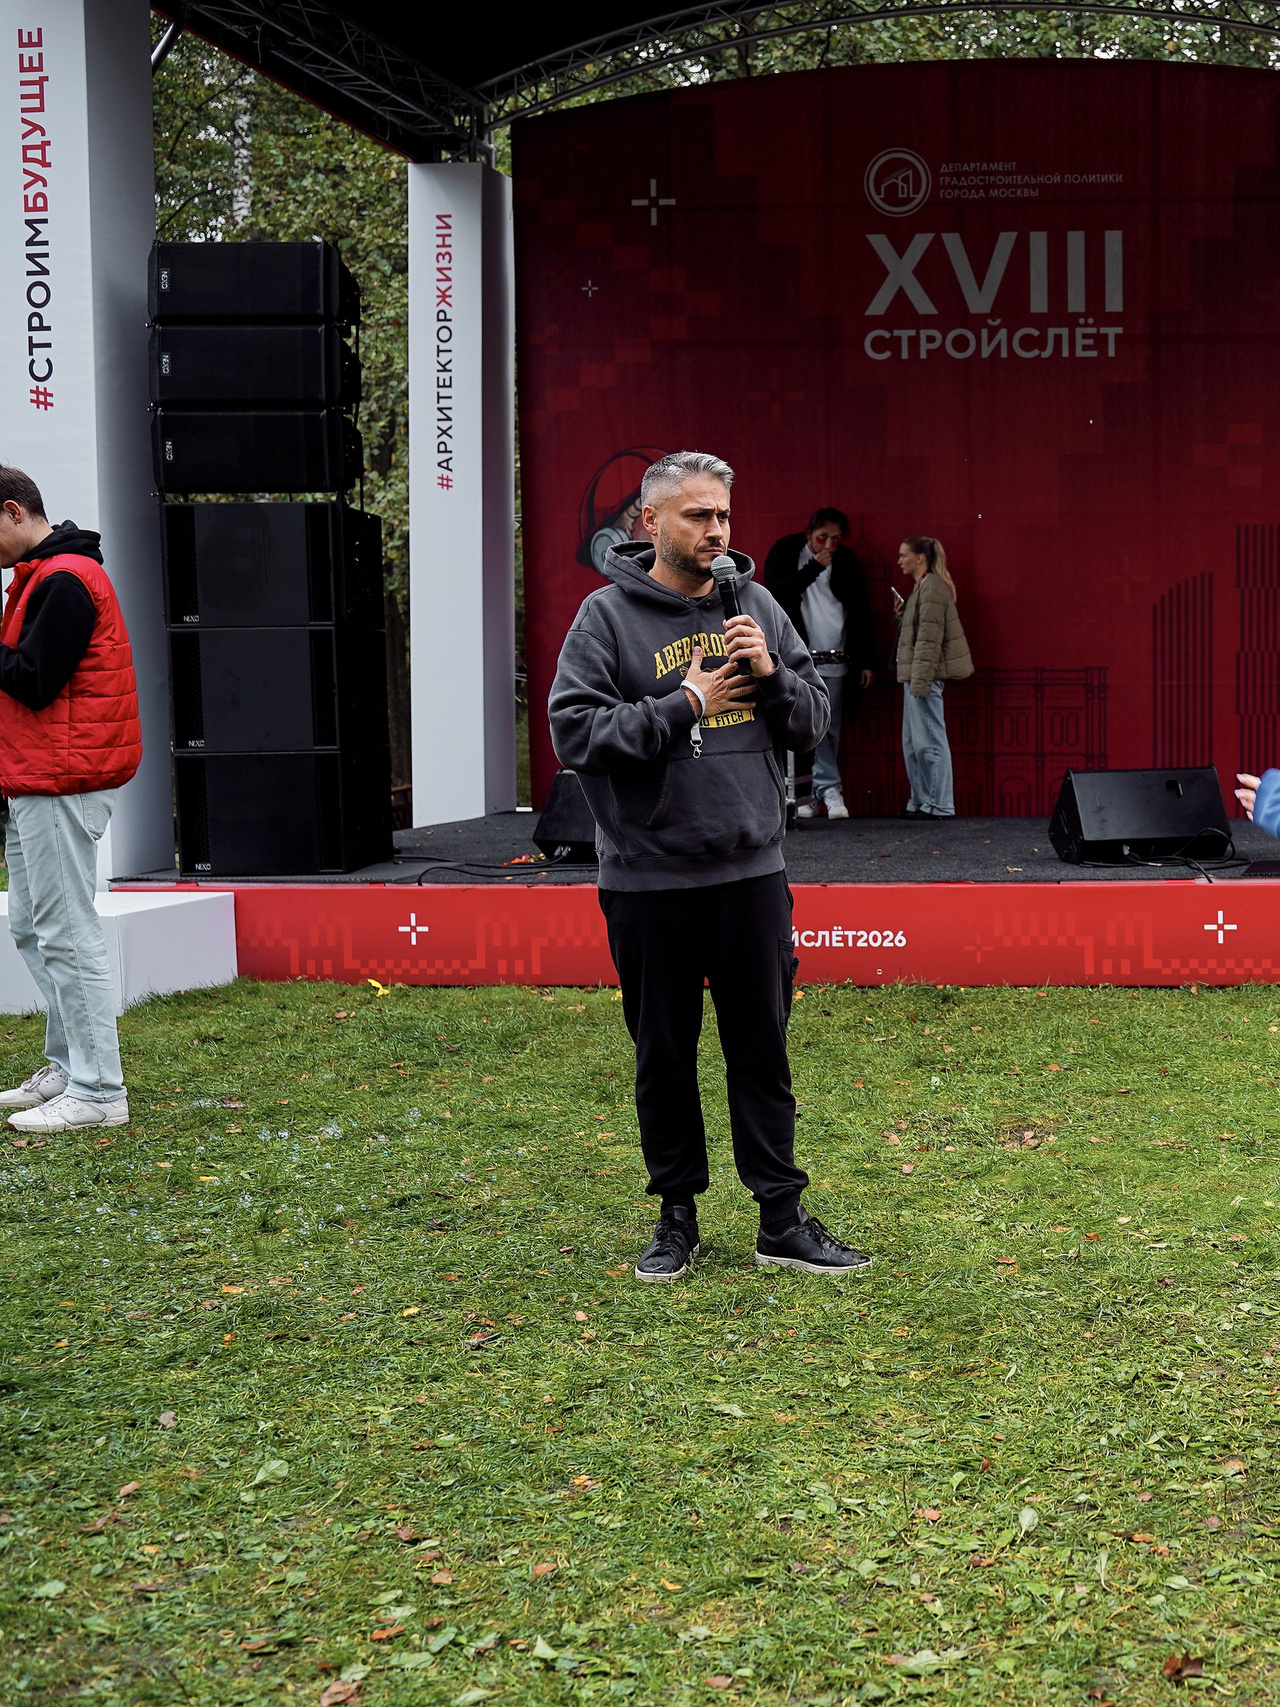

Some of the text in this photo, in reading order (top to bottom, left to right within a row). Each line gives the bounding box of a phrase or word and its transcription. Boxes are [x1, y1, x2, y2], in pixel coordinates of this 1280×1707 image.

[940, 162, 1017, 173] ДЕПАРТАМЕНТ
[940, 173, 1123, 186] ГРАДОСТРОИТЕЛЬНОЙ ПОЛИТИКИ
[940, 188, 1039, 199] ГОРОДА МОСКВЫ
[18, 27, 54, 411] #СТРОИМБУДУЩЕЕ
[864, 230, 1123, 315] XVIII
[436, 213, 454, 491] #АРХИТЕКТОРЖИЗНИ
[864, 317, 1124, 360] СТРОЙСЛЁТ
[714, 710, 744, 726] FITCH
